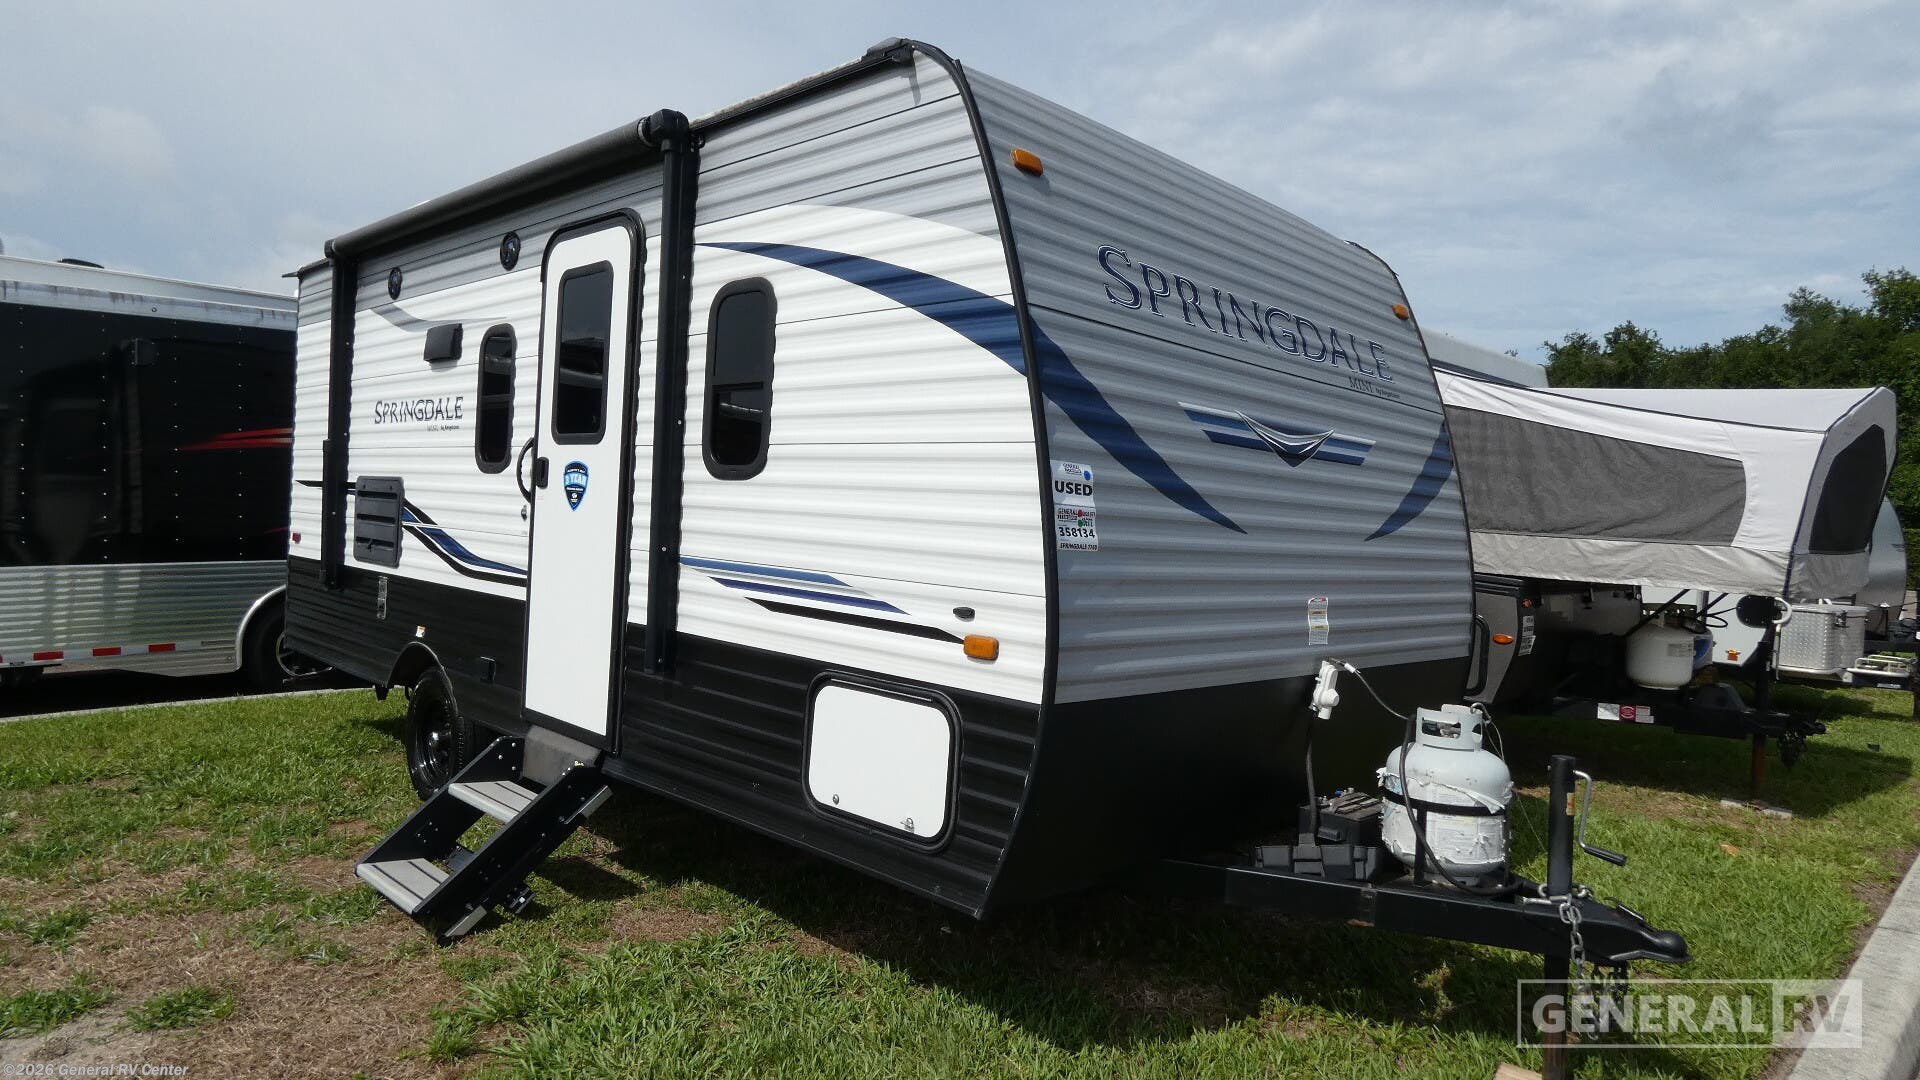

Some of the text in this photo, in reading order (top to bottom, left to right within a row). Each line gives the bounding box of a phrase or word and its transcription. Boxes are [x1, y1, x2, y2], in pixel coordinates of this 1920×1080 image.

[1097, 244, 1394, 382] SPRINGDALE
[374, 396, 463, 424] SPRINGDALE
[1055, 480, 1093, 496] USED
[1058, 527, 1096, 538] 358134
